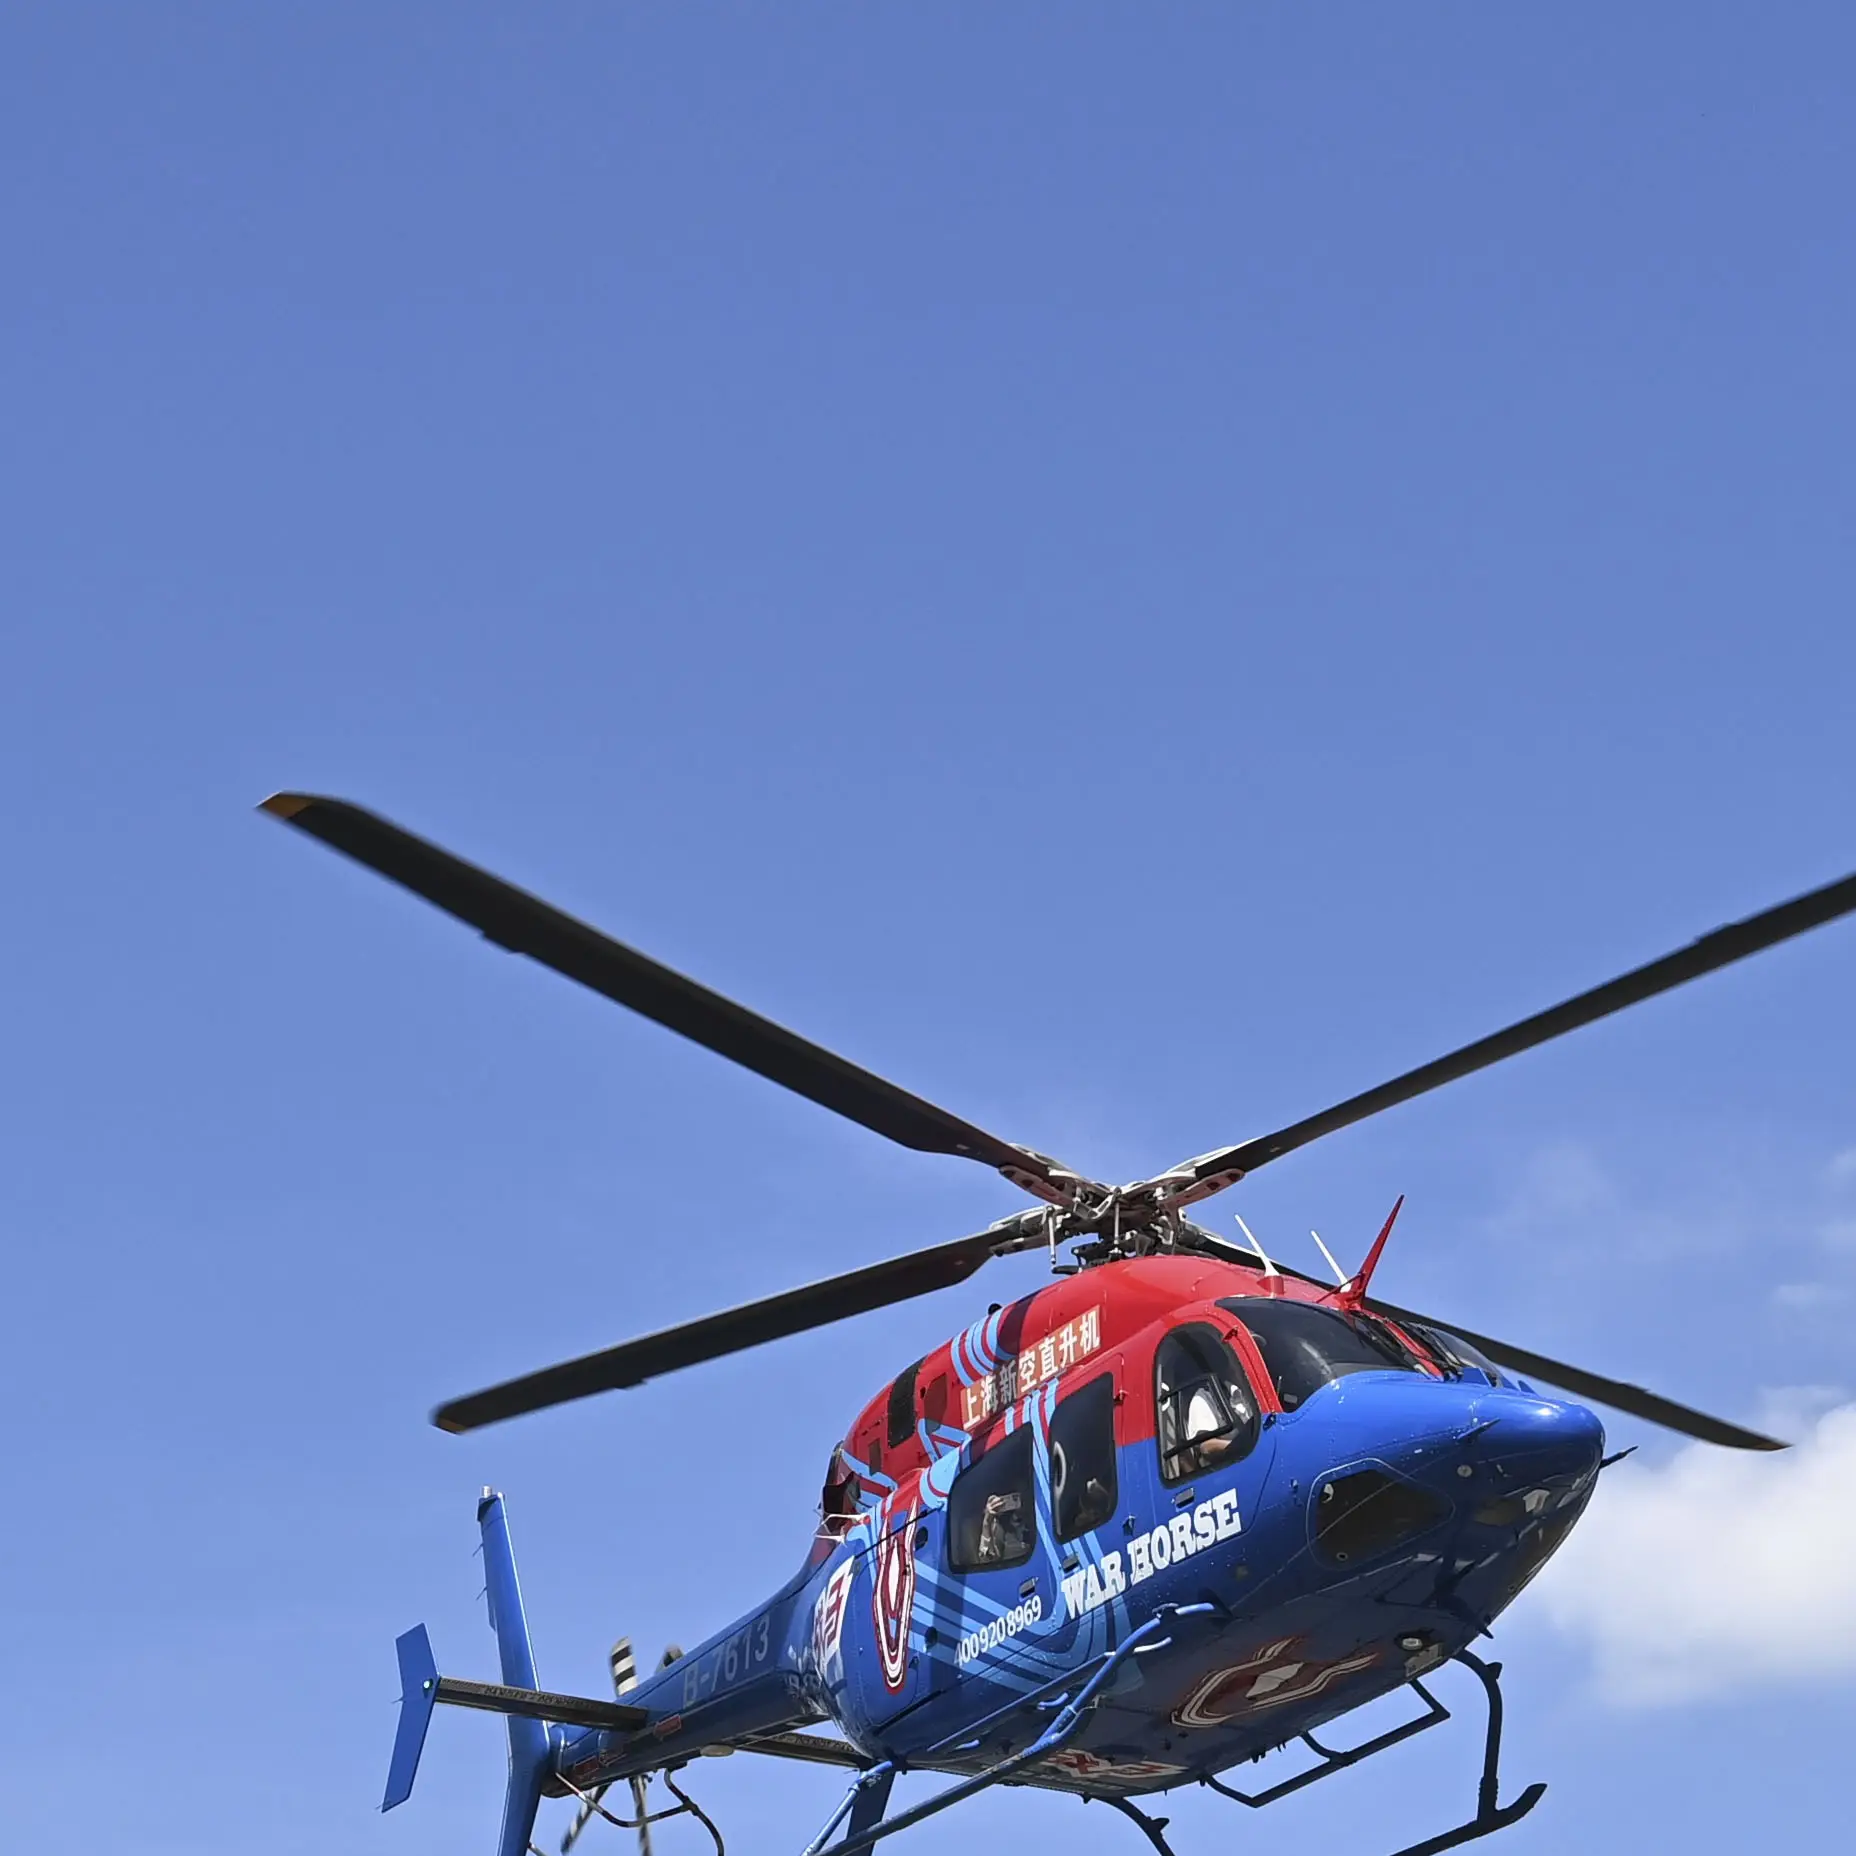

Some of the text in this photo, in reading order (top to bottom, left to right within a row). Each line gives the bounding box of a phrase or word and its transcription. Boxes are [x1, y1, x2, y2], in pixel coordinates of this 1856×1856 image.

[963, 1310, 1101, 1431] 上海新空直升机
[1060, 1488, 1242, 1620] WAR HORSE
[682, 1613, 771, 1710] B-7613
[954, 1595, 1042, 1667] 4009208969
